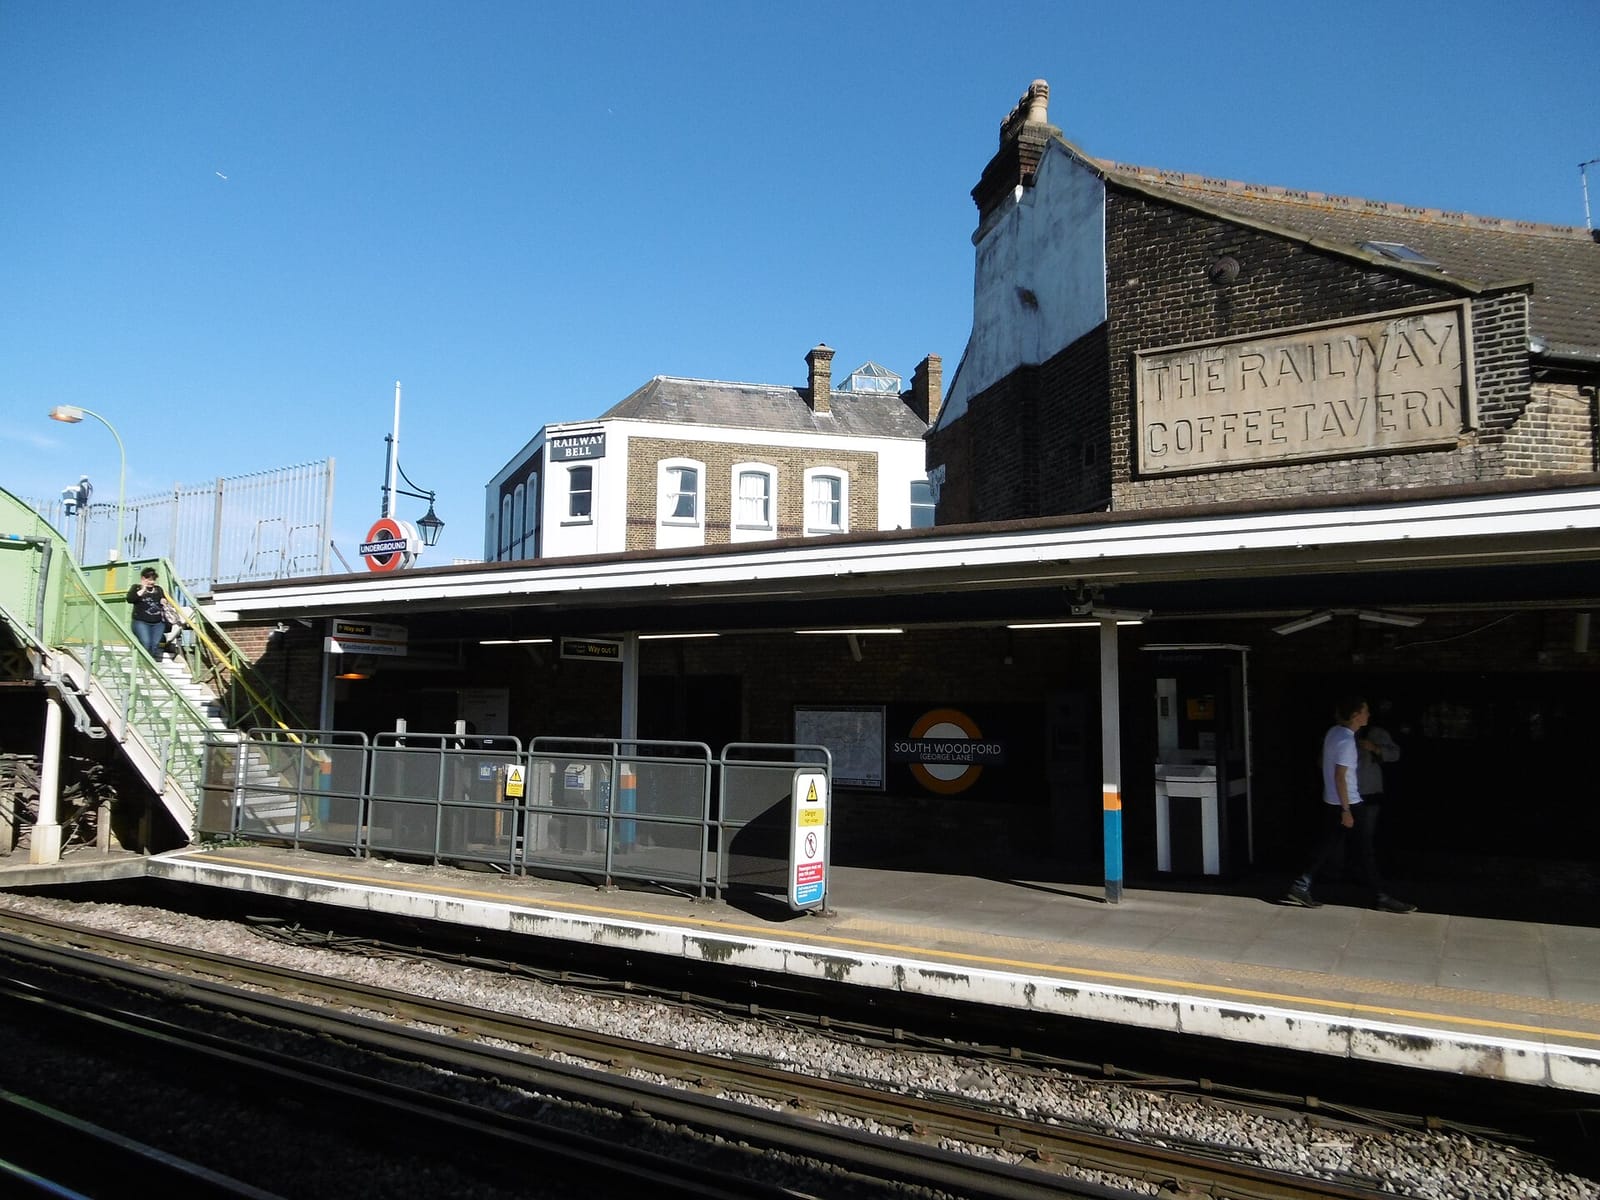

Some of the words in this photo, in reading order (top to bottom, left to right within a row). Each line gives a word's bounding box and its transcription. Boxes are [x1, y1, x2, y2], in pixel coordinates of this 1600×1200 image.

[1146, 358, 1226, 401] THE
[1238, 324, 1454, 392] RAILWAY
[1147, 406, 1288, 458] COFFEE
[1291, 383, 1462, 442] TAVERN
[553, 434, 604, 448] RAILWAY
[565, 446, 592, 457] BELL
[360, 541, 406, 553] UNDERGROUND
[587, 644, 600, 654] Way
[601, 646, 612, 654] out
[894, 742, 931, 753] SOUTH
[934, 743, 1001, 755] WOODFORD
